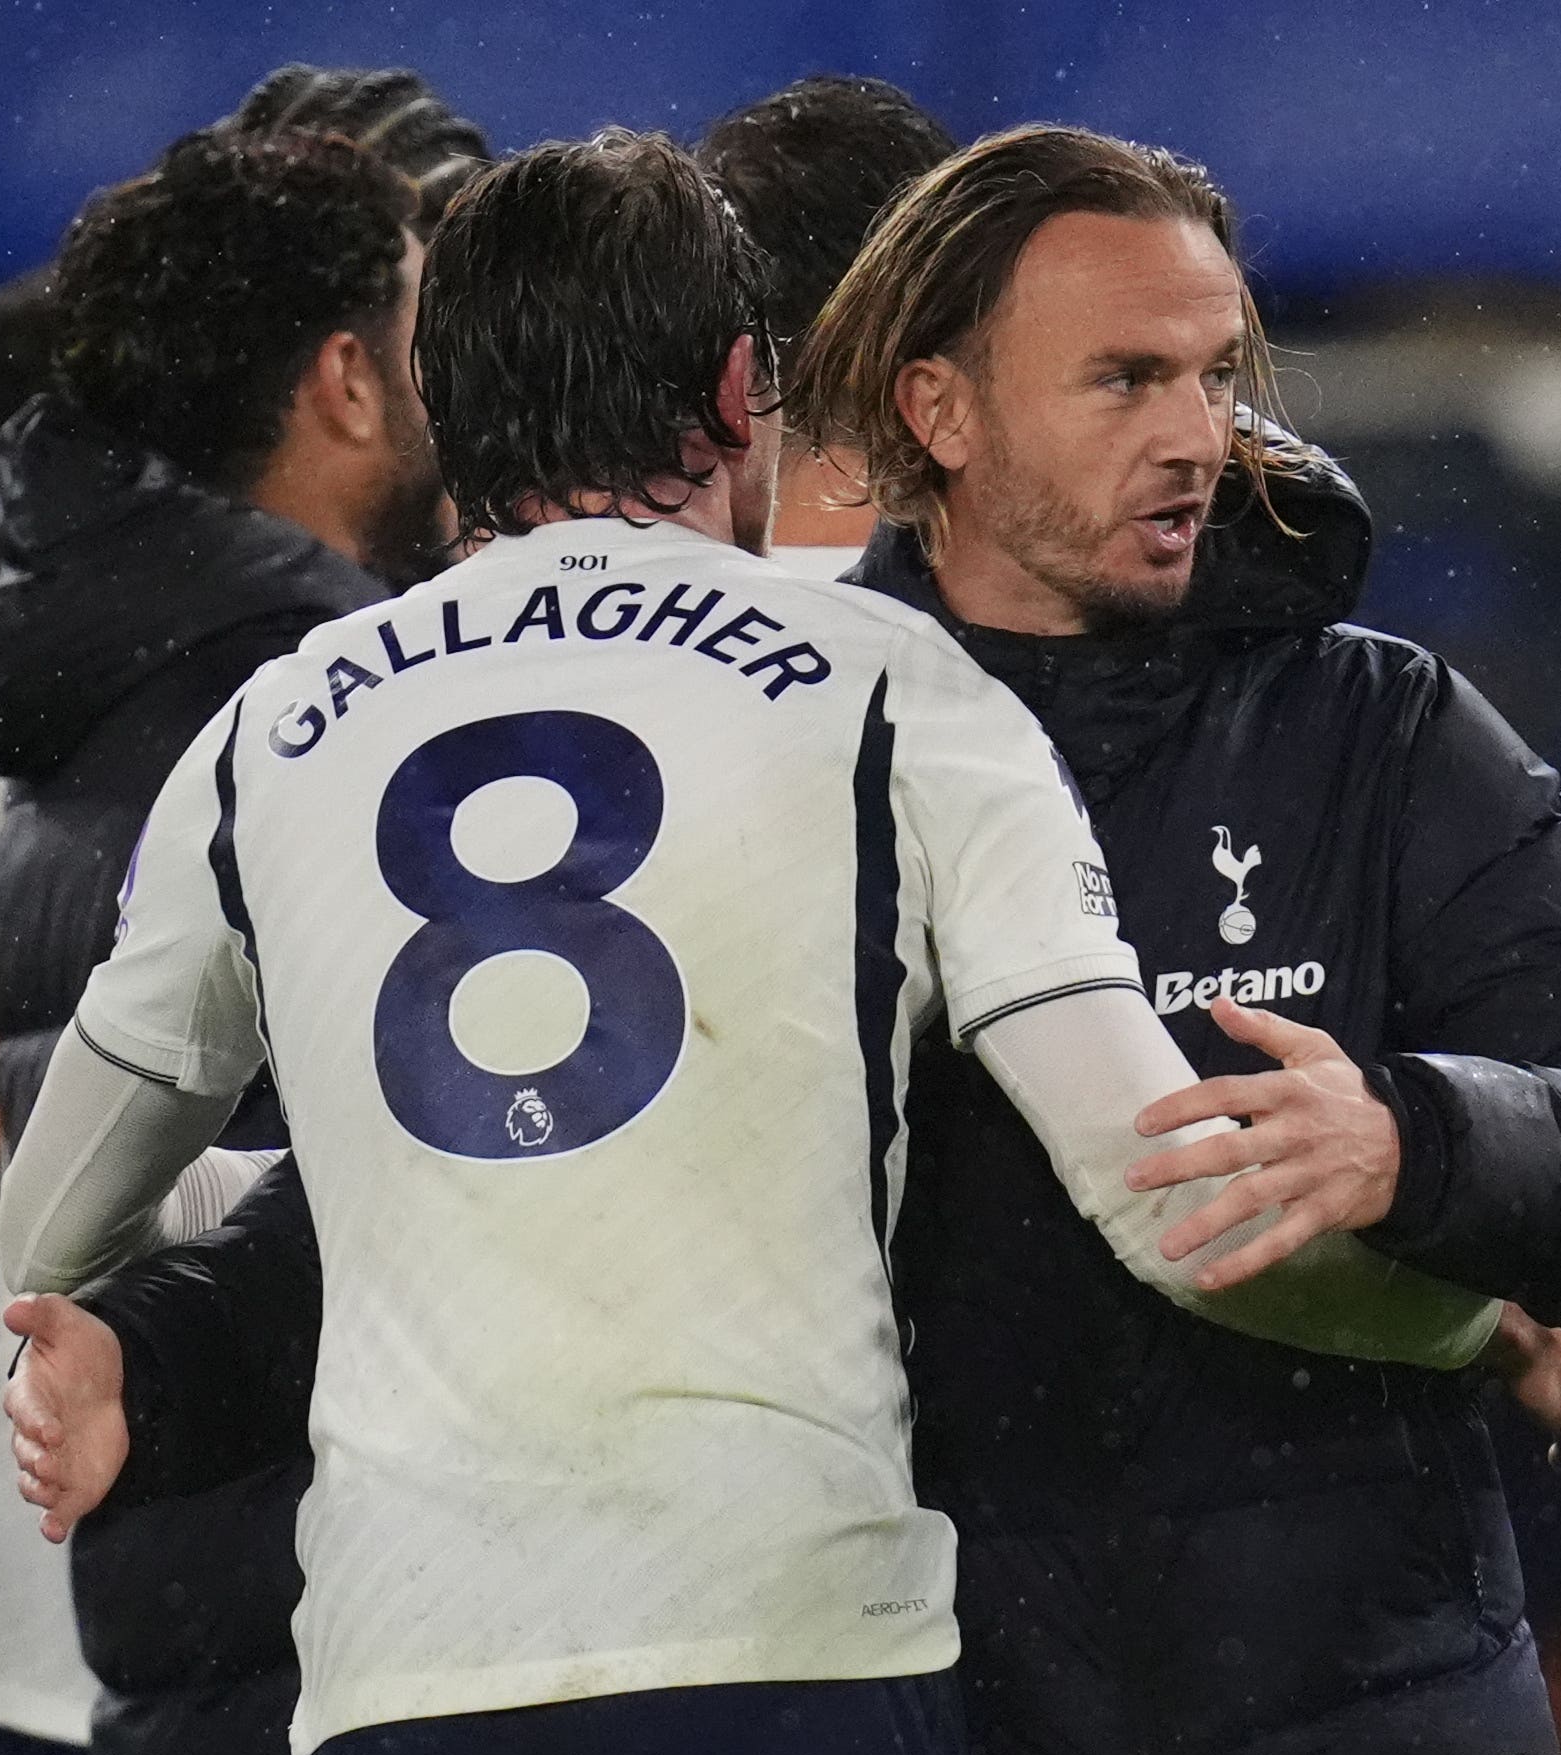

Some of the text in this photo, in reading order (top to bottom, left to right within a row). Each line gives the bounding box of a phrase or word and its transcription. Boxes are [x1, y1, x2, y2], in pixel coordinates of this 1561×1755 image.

[559, 554, 608, 571] 901
[267, 582, 833, 759] GALLAGHER
[373, 709, 691, 1161] 8
[1155, 961, 1325, 1016] Betano
